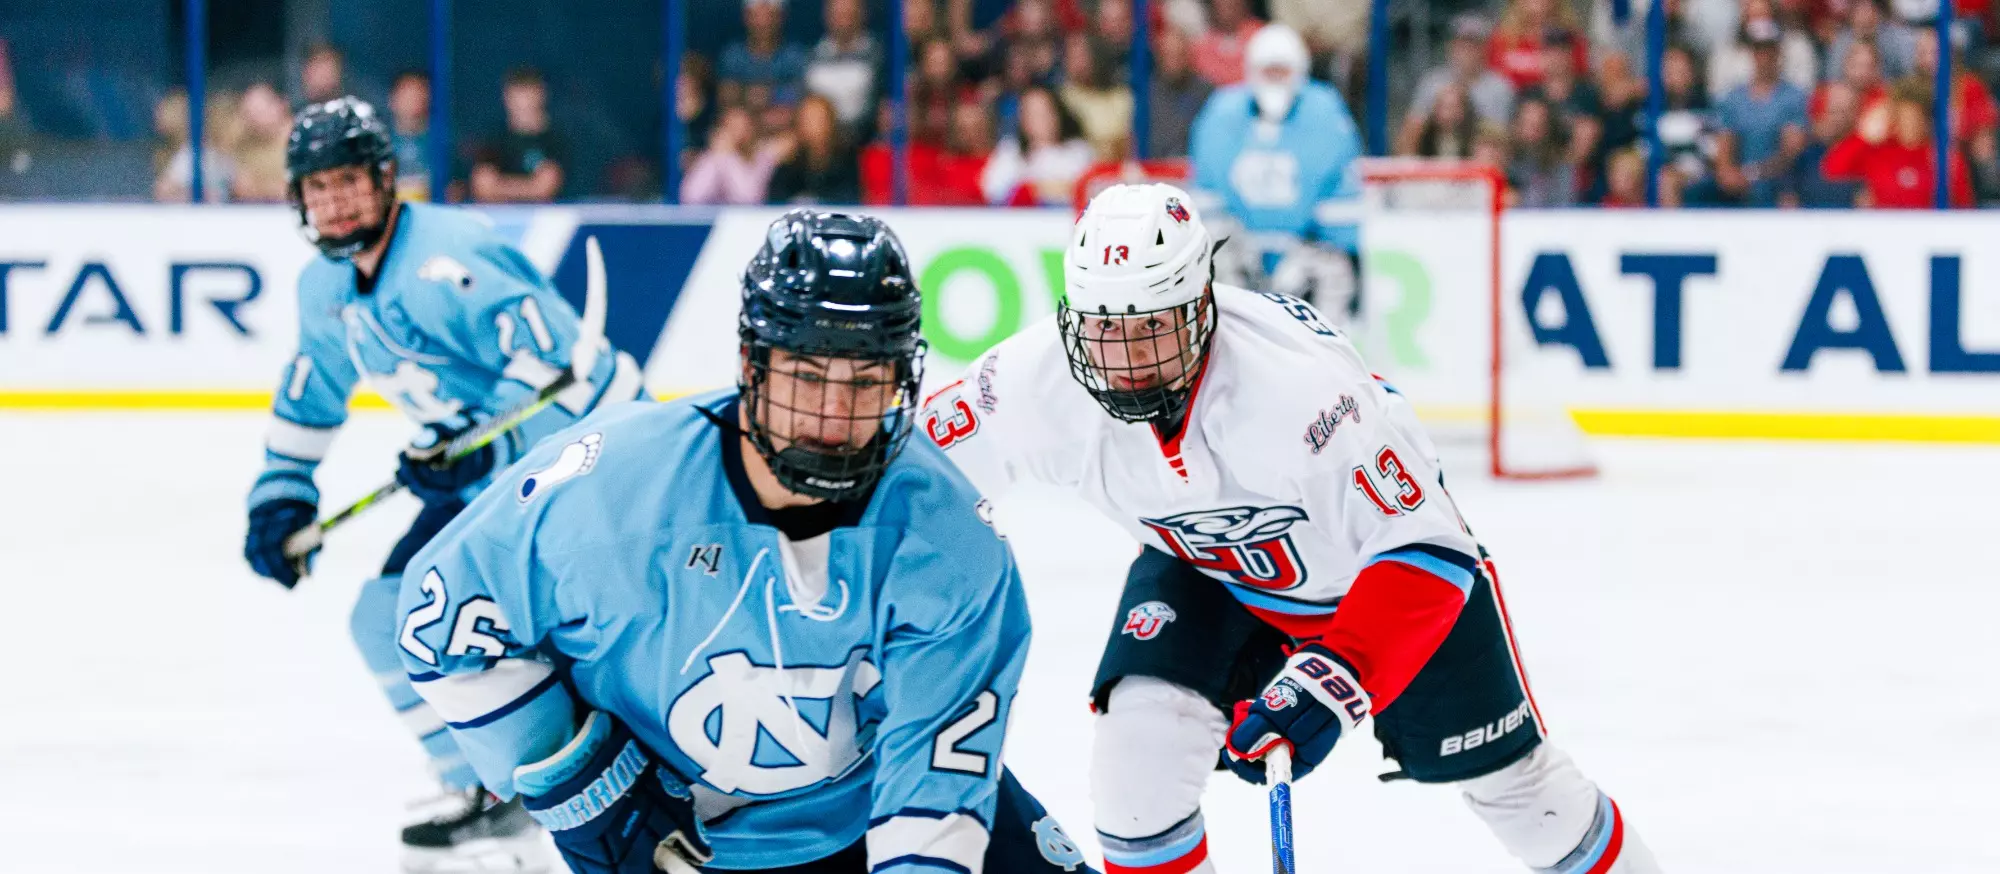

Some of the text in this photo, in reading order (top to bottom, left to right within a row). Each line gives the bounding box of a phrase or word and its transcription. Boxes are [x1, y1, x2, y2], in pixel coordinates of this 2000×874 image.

[1103, 244, 1129, 265] 13
[1521, 253, 1718, 369] AT
[1304, 394, 1361, 454] Liberty
[1352, 444, 1426, 517] 13
[398, 565, 518, 671] 26
